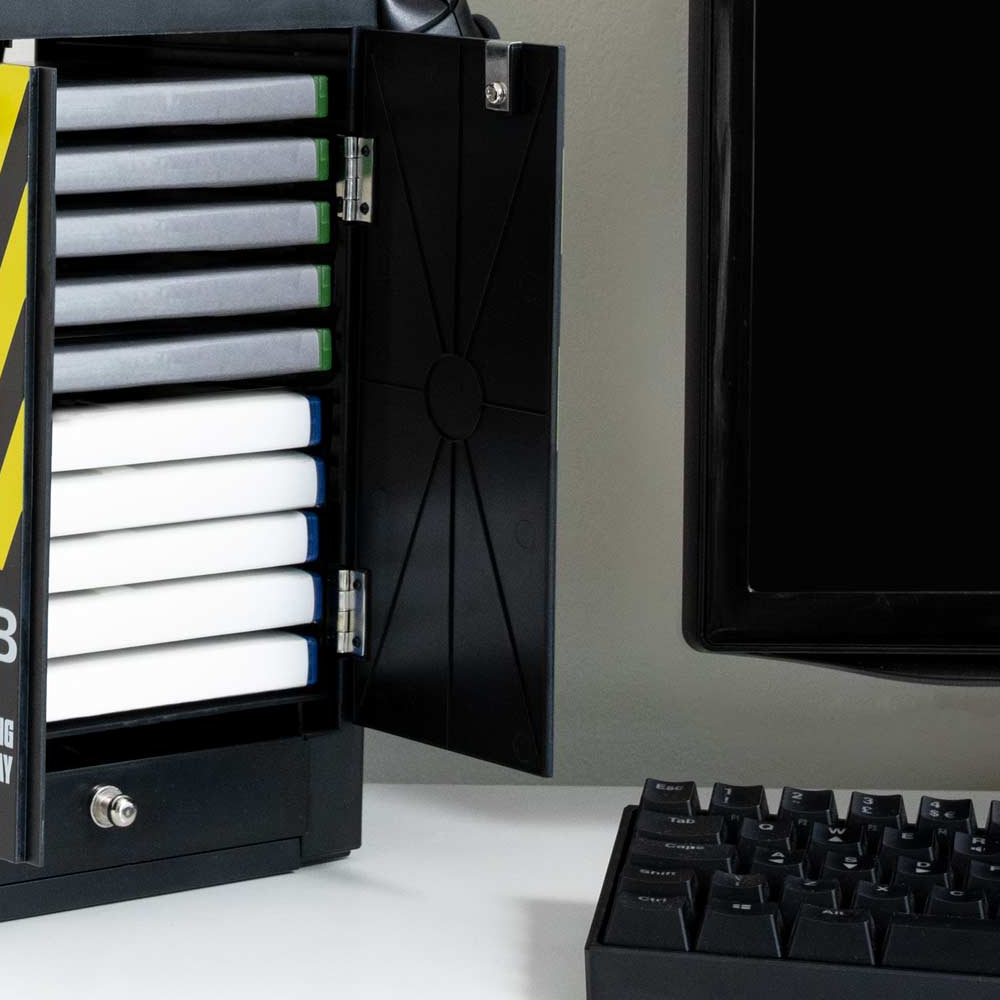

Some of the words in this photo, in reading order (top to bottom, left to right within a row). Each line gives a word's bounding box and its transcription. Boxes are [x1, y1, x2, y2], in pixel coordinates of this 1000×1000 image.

[655, 783, 685, 791] Esc
[668, 817, 696, 825] Tab
[758, 823, 775, 831] Q
[828, 826, 848, 835] W
[665, 842, 705, 850] Caps
